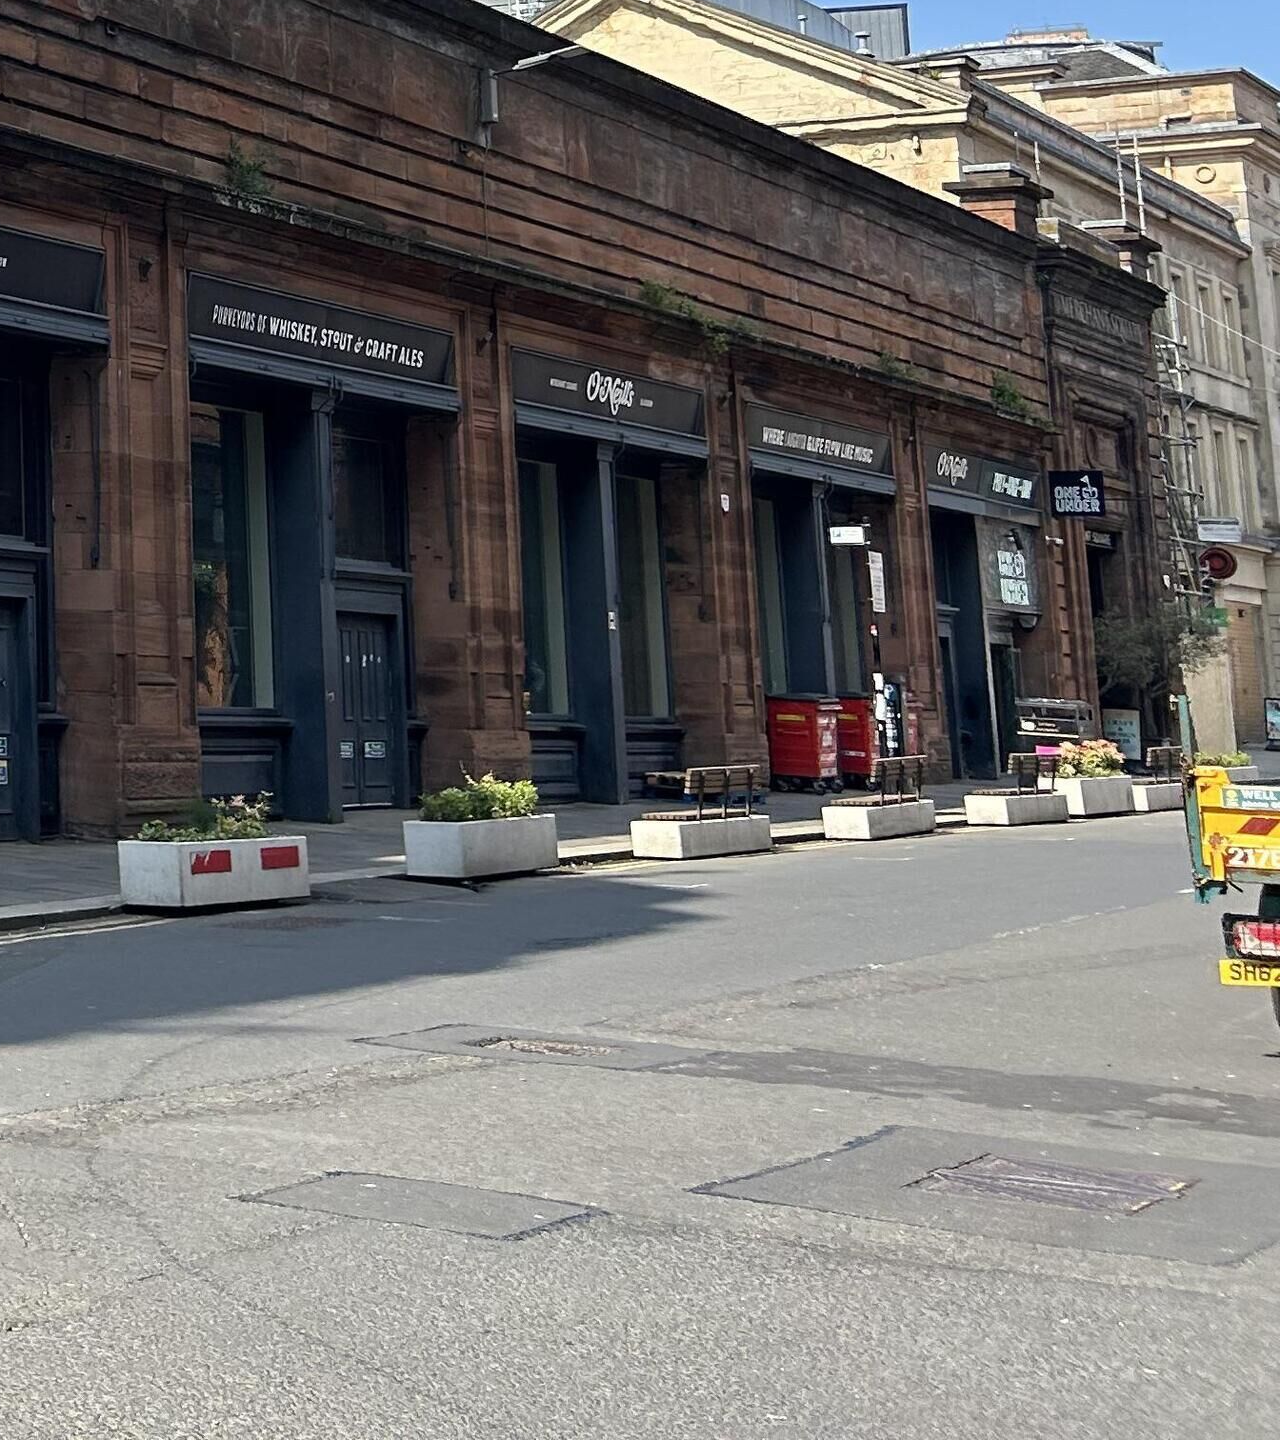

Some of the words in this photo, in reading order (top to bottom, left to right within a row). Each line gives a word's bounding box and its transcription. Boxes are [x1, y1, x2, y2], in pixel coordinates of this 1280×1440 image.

[212, 304, 256, 331] PURVEYORS
[256, 314, 269, 335] OF
[269, 316, 319, 347] WHISKEY,
[320, 328, 354, 353] STOUT
[354, 337, 365, 354] &
[365, 338, 398, 361] CRAFT
[398, 346, 425, 368] ALES
[586, 371, 635, 416] O'Neill's
[1054, 486, 1081, 500] ONE
[1055, 499, 1101, 512] UNDER
